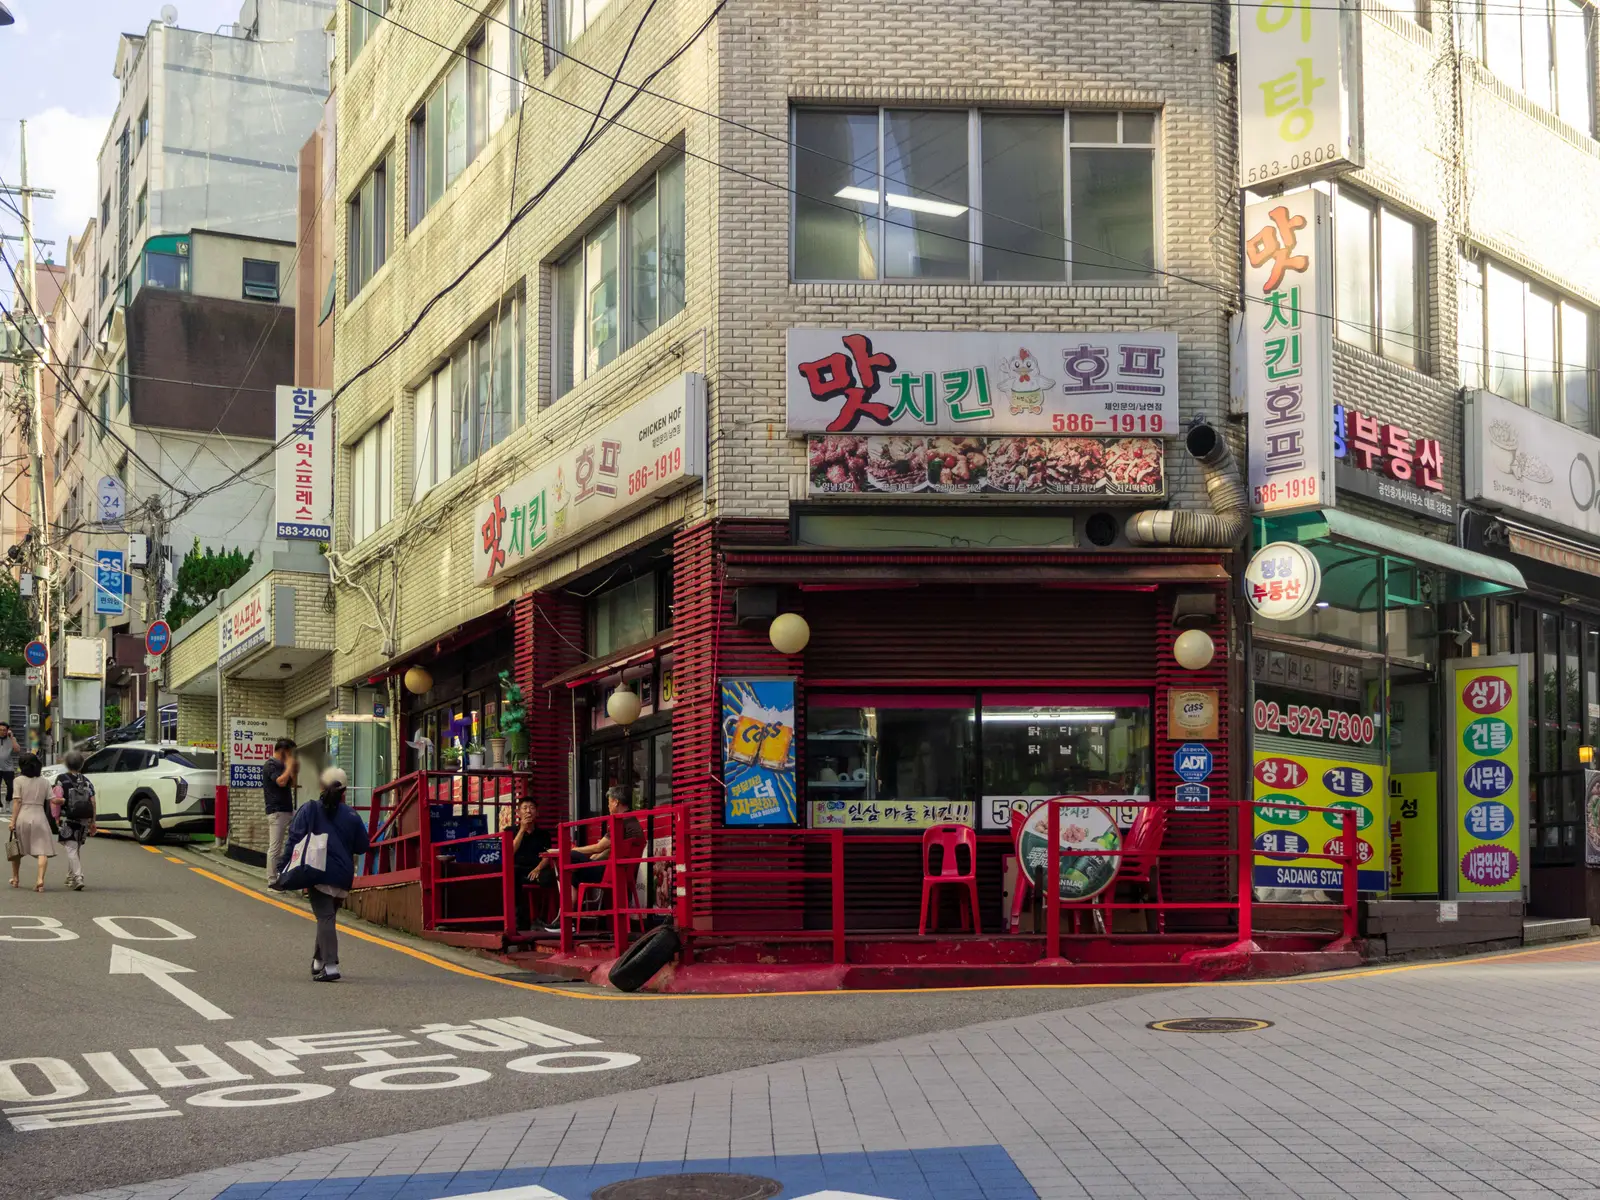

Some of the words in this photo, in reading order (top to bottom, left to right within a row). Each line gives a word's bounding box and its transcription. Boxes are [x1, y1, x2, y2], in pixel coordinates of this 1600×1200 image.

[1248, 143, 1336, 183] 583-0808
[798, 334, 994, 433] 맛치킨
[1061, 343, 1165, 397] 호프
[292, 387, 317, 441] 한국
[638, 415, 667, 441] CHICKEN
[668, 407, 682, 424] HOF
[1052, 413, 1163, 433] 586-1919
[1264, 384, 1305, 476] 호프
[1347, 410, 1444, 492] 부동산
[295, 443, 313, 520] 익스프레스
[574, 438, 622, 507] 호프
[628, 447, 682, 496] 586-1919
[103, 495, 120, 509] 24
[1254, 476, 1316, 504] 586-1919
[278, 525, 329, 538] 583-2400
[481, 487, 548, 578] 맛치킨
[99, 557, 121, 573] GS
[1261, 556, 1293, 579] 명성
[99, 571, 121, 587] 25
[1252, 578, 1301, 603] 부동산
[1183, 702, 1204, 713] Cass
[1470, 681, 1506, 709] 상가
[742, 720, 783, 743] Cass
[1253, 699, 1374, 745] 02-522-7300
[233, 729, 254, 741] 한국
[1471, 722, 1507, 750] 건물
[233, 743, 274, 761] 익스프레
[1180, 755, 1207, 770] ADT
[234, 765, 263, 774] 02-583-
[1262, 761, 1299, 785] 상가
[1331, 770, 1365, 793] 건물
[1469, 766, 1506, 791] 사무실
[753, 778, 776, 799] 더
[848, 802, 881, 822] 인삼
[884, 804, 917, 821] 마늘
[923, 803, 969, 821] 치킨!!
[1471, 805, 1505, 832] 원룸
[1277, 867, 1318, 885] SADANG
[1320, 869, 1343, 885] STAT
[1468, 852, 1510, 880] 사당역상권
[0, 914, 197, 941] 30
[0, 1016, 642, 1132] 일방통행
